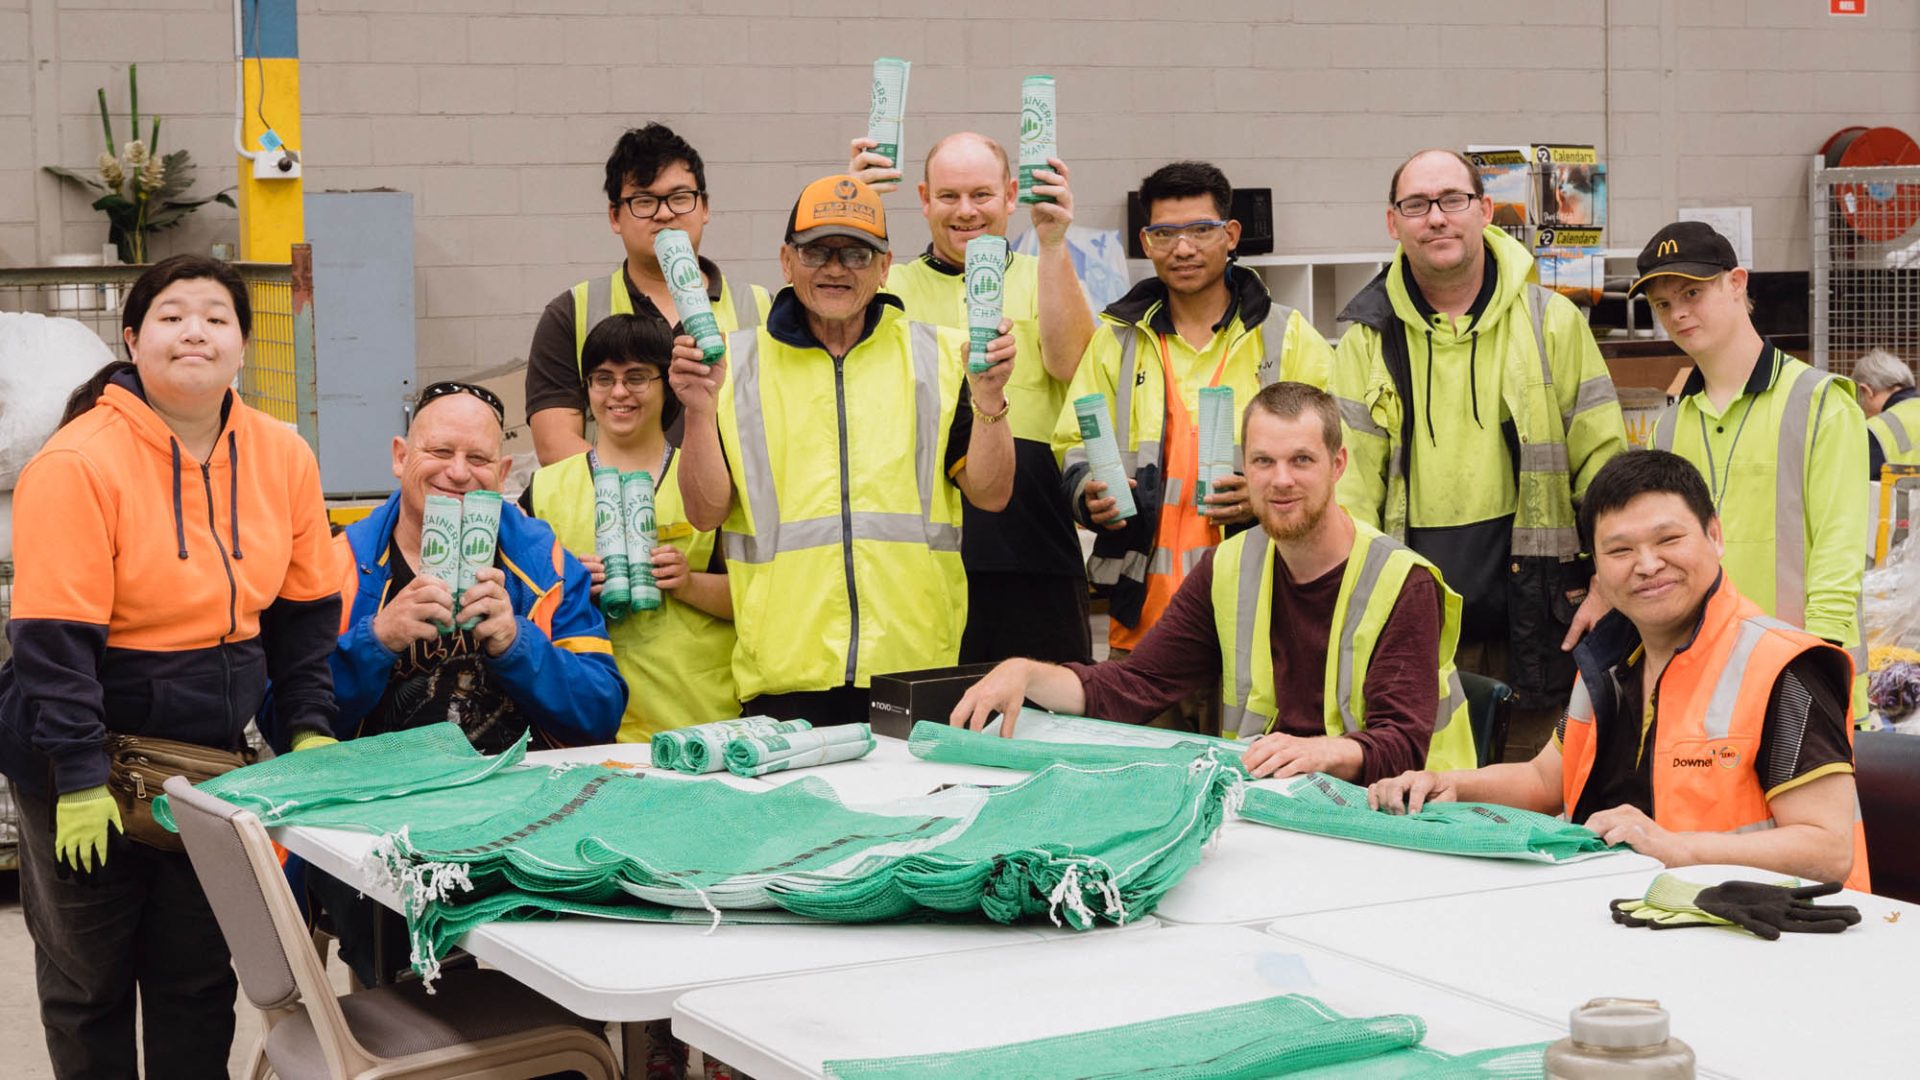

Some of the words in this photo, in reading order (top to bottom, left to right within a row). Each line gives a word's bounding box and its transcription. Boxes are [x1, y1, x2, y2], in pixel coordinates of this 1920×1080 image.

[1554, 149, 1594, 163] Calendars
[1542, 233, 1552, 246] $2
[1557, 232, 1598, 245] Calendars
[876, 701, 892, 711] novo
